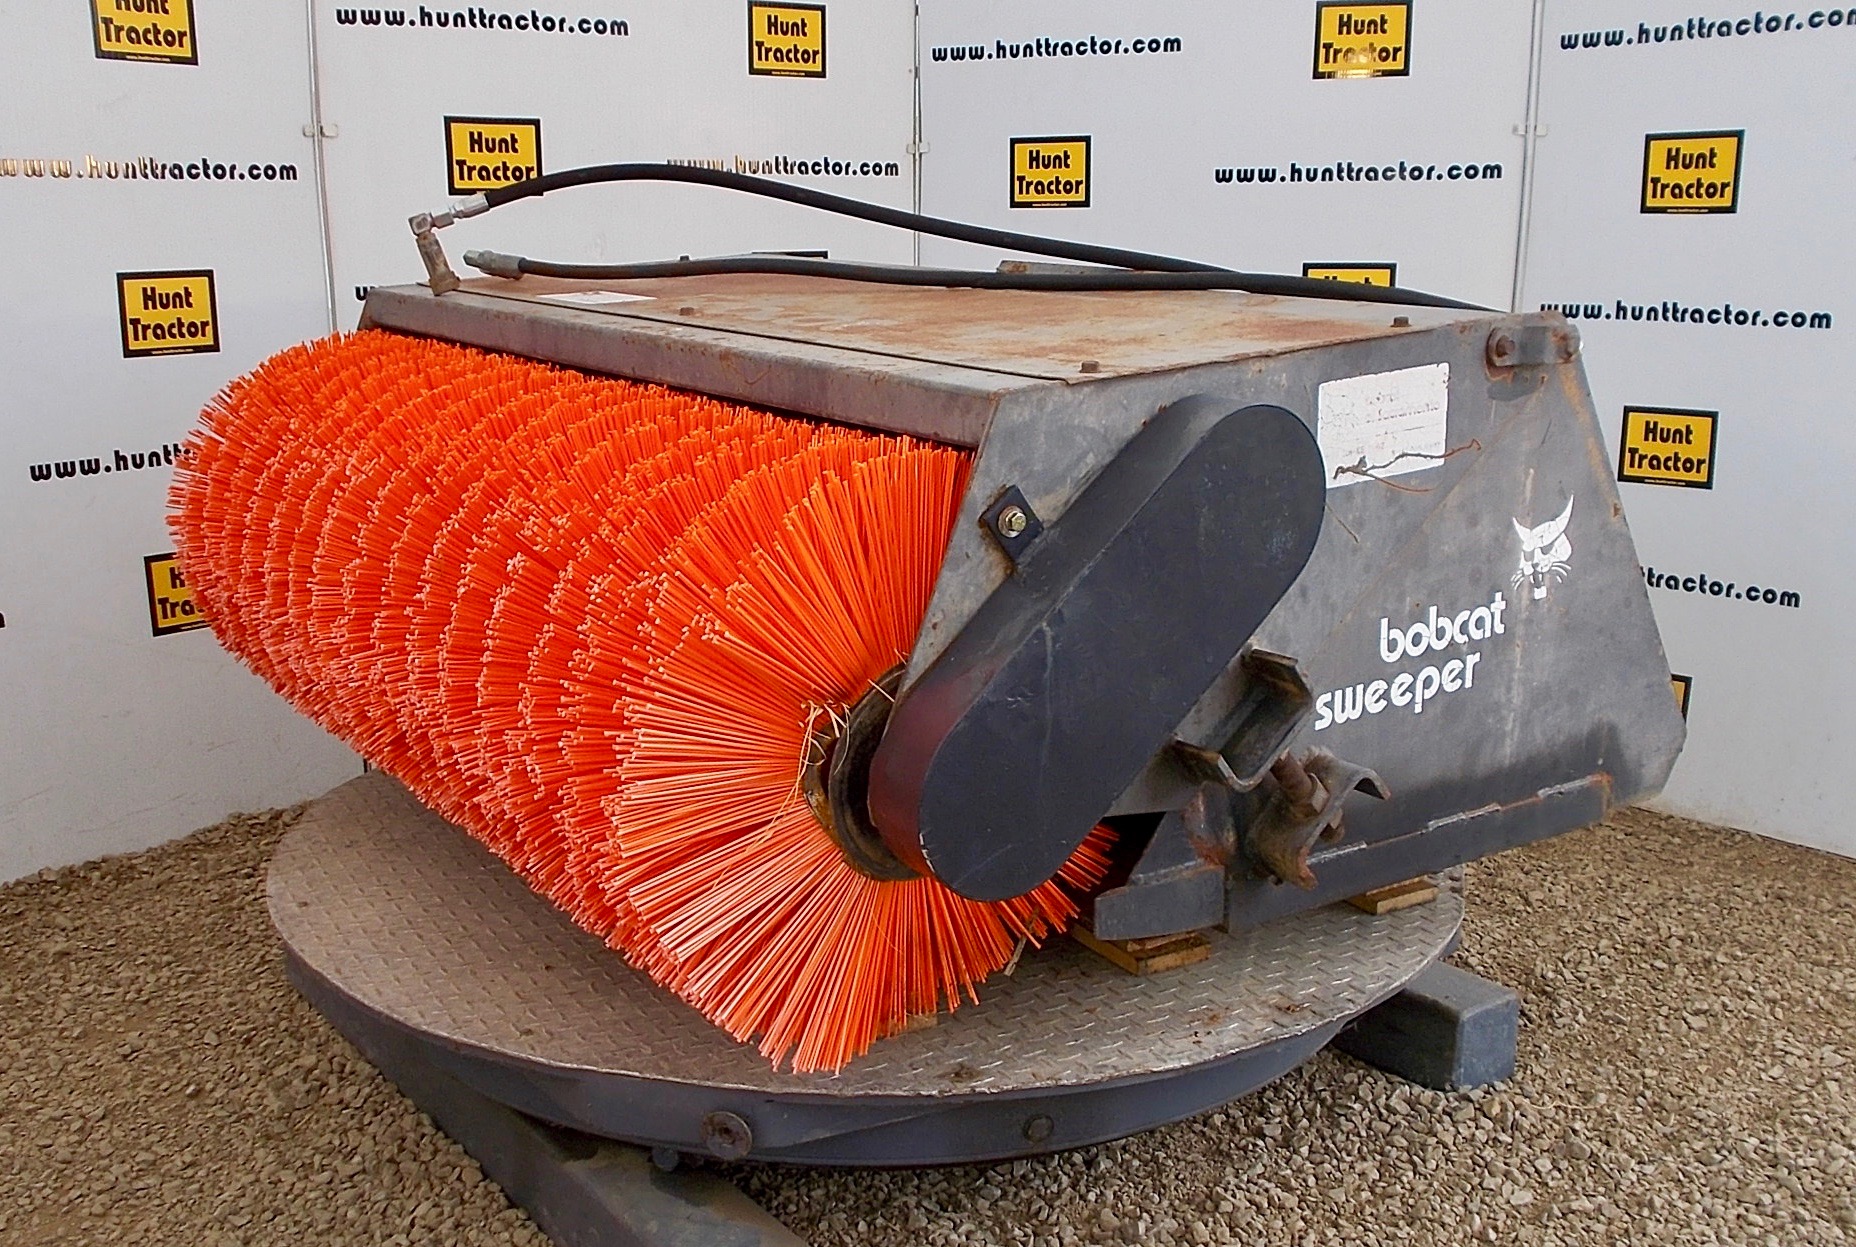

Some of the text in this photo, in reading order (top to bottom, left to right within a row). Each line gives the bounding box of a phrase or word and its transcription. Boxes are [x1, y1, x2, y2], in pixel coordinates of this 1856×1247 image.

[101, 16, 187, 49] Tractor
[336, 5, 630, 37] www.hunttractor.com
[766, 14, 808, 38] Hunt
[1337, 13, 1389, 36] Hunt
[755, 42, 820, 66] Tractor
[932, 34, 1183, 63] www.hunttractor.com
[468, 131, 519, 154] Hunt
[0, 155, 298, 181] www.hunttractor.com
[455, 159, 535, 182] Tractor
[1028, 149, 1071, 170] Hunt
[1665, 147, 1717, 170] Hunt
[1214, 161, 1503, 184] www.hunttractor.com
[1016, 174, 1084, 197] Tractor
[1649, 176, 1731, 201] Tractor
[141, 286, 193, 311] Hunt
[129, 317, 210, 343] Tractor
[1643, 420, 1694, 445] Hunt
[1627, 447, 1707, 476] Tractor
[1380, 591, 1507, 663] bobcat
[1314, 651, 1482, 732] sweeper
